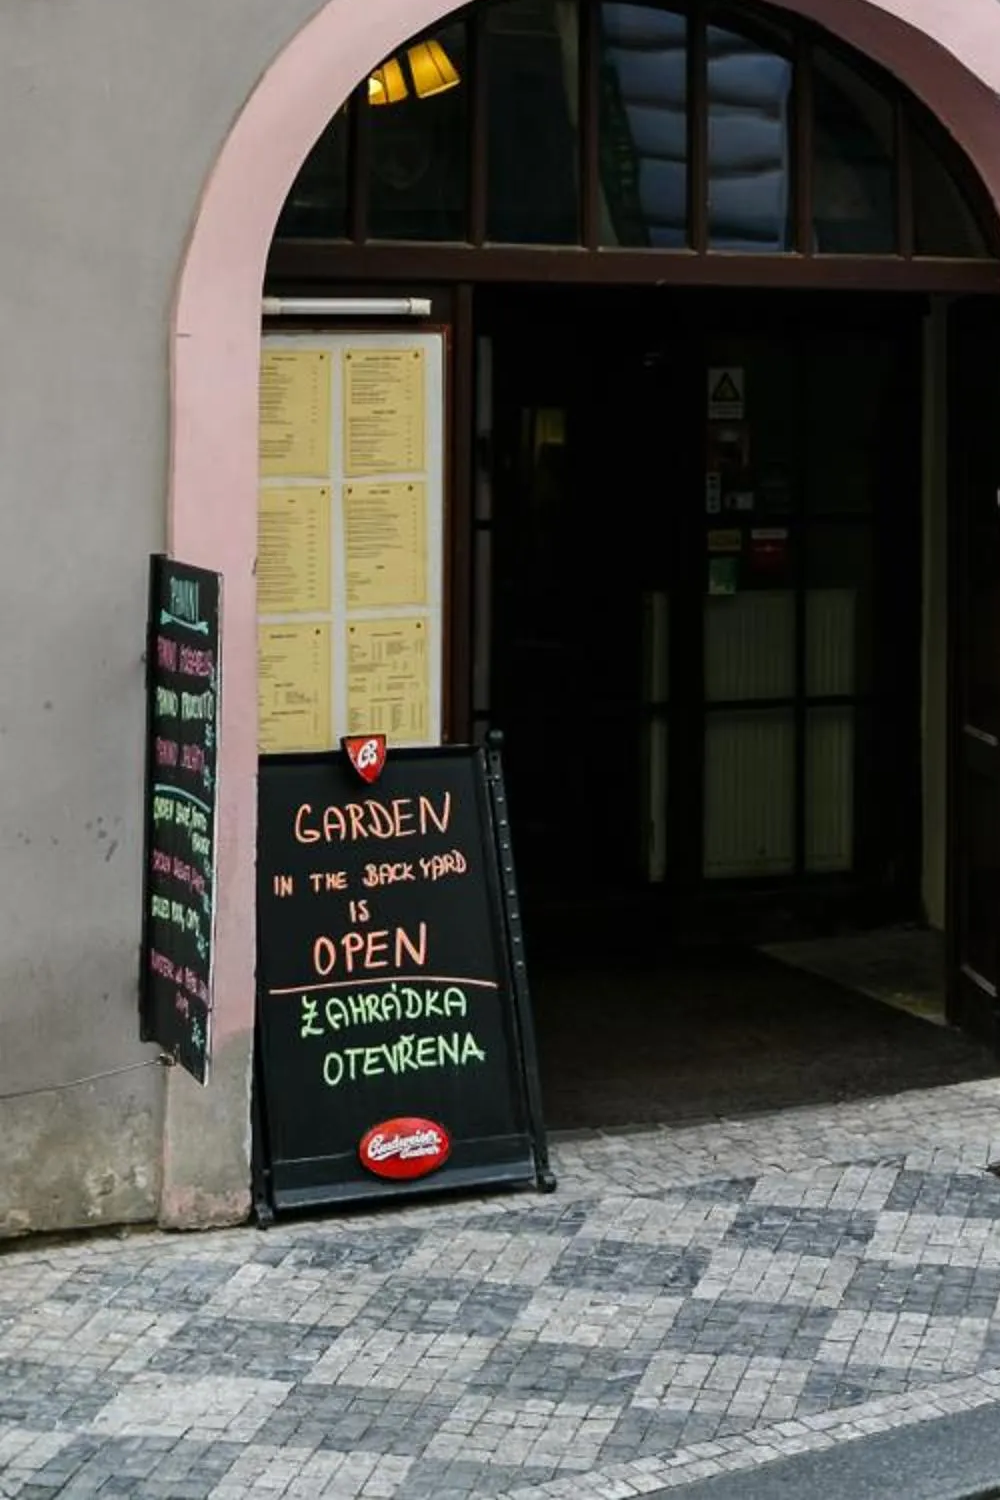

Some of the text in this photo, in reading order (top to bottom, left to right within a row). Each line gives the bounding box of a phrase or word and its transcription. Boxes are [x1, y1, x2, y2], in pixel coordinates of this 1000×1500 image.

[294, 790, 452, 844] GARDEN
[273, 848, 468, 898] IN THE BACK YARD
[349, 899, 371, 924] IS
[313, 921, 428, 977] OPEN
[301, 982, 468, 1039] ZAHRÁDKA
[322, 1031, 486, 1087] OTEVŘENA
